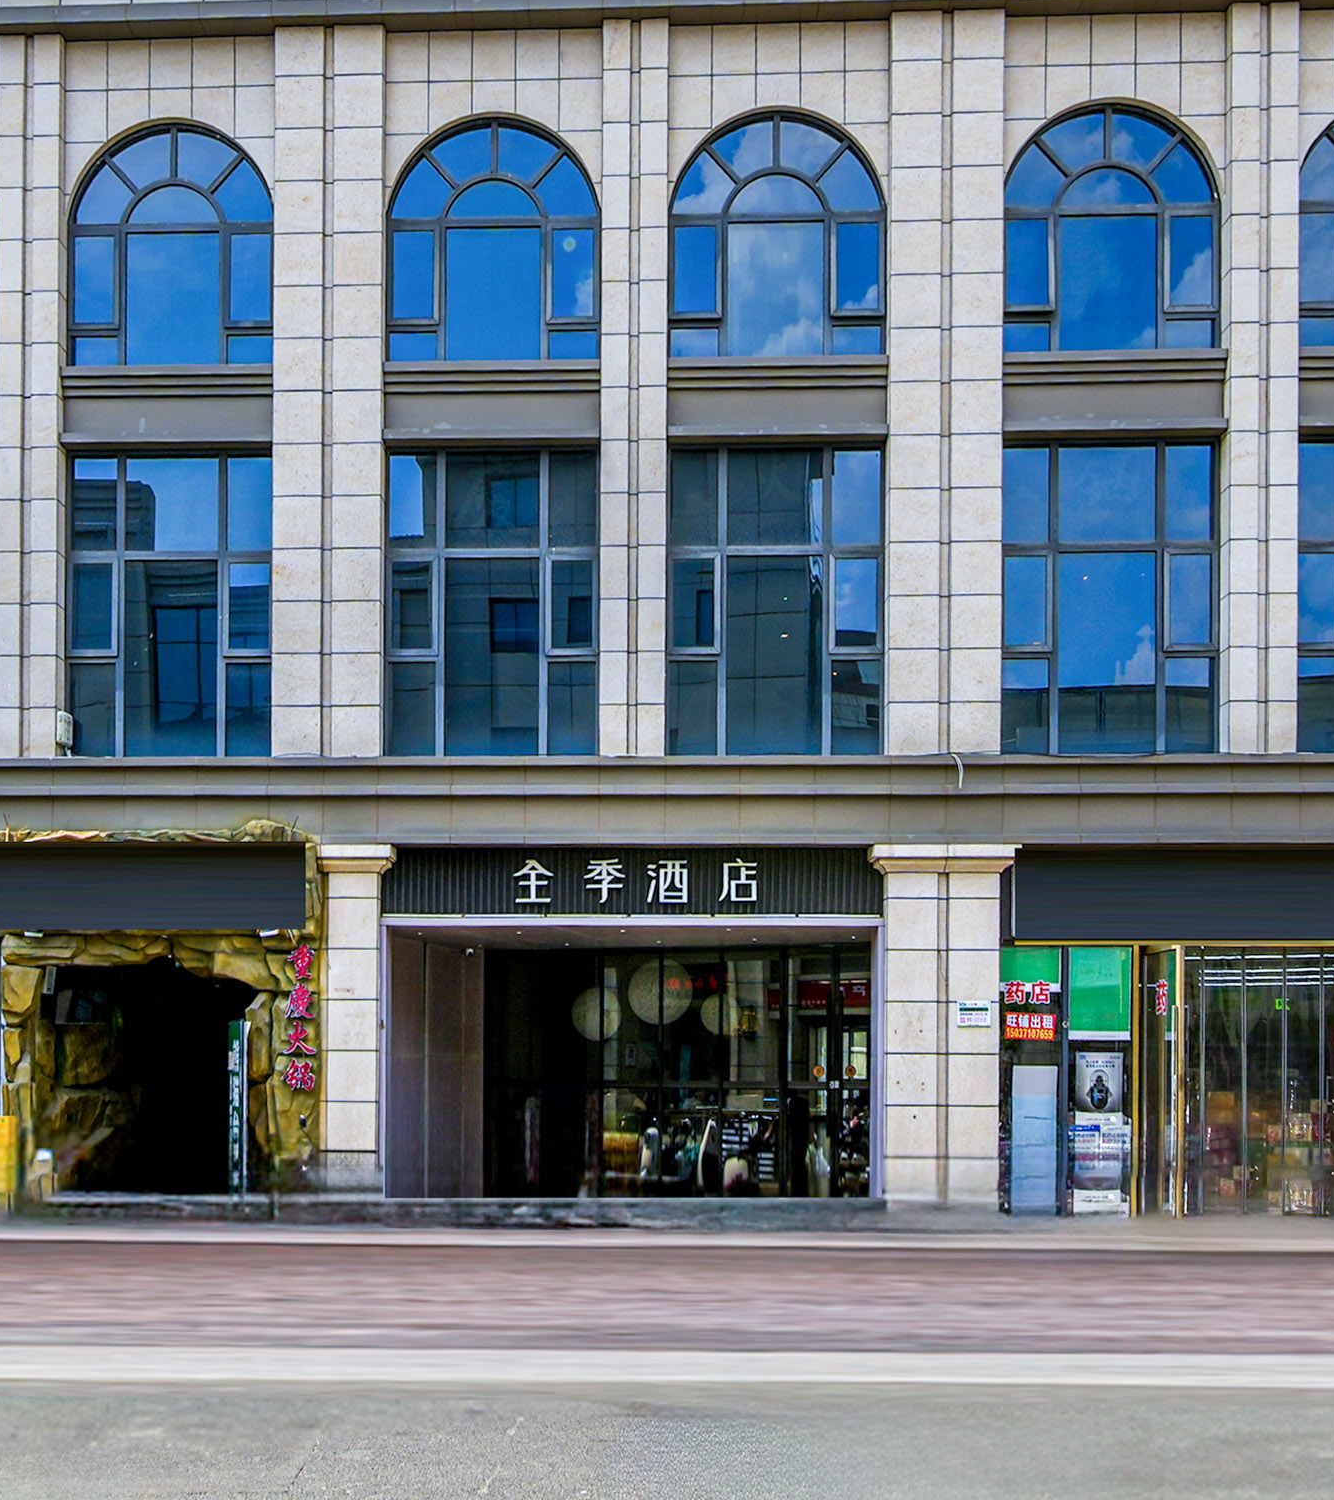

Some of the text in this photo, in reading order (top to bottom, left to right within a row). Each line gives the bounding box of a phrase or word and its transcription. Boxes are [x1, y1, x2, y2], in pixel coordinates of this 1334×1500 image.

[512, 857, 760, 904] 全季酒店
[1004, 981, 1051, 1005] 药店
[1007, 1014, 1054, 1029] 旺铺出租
